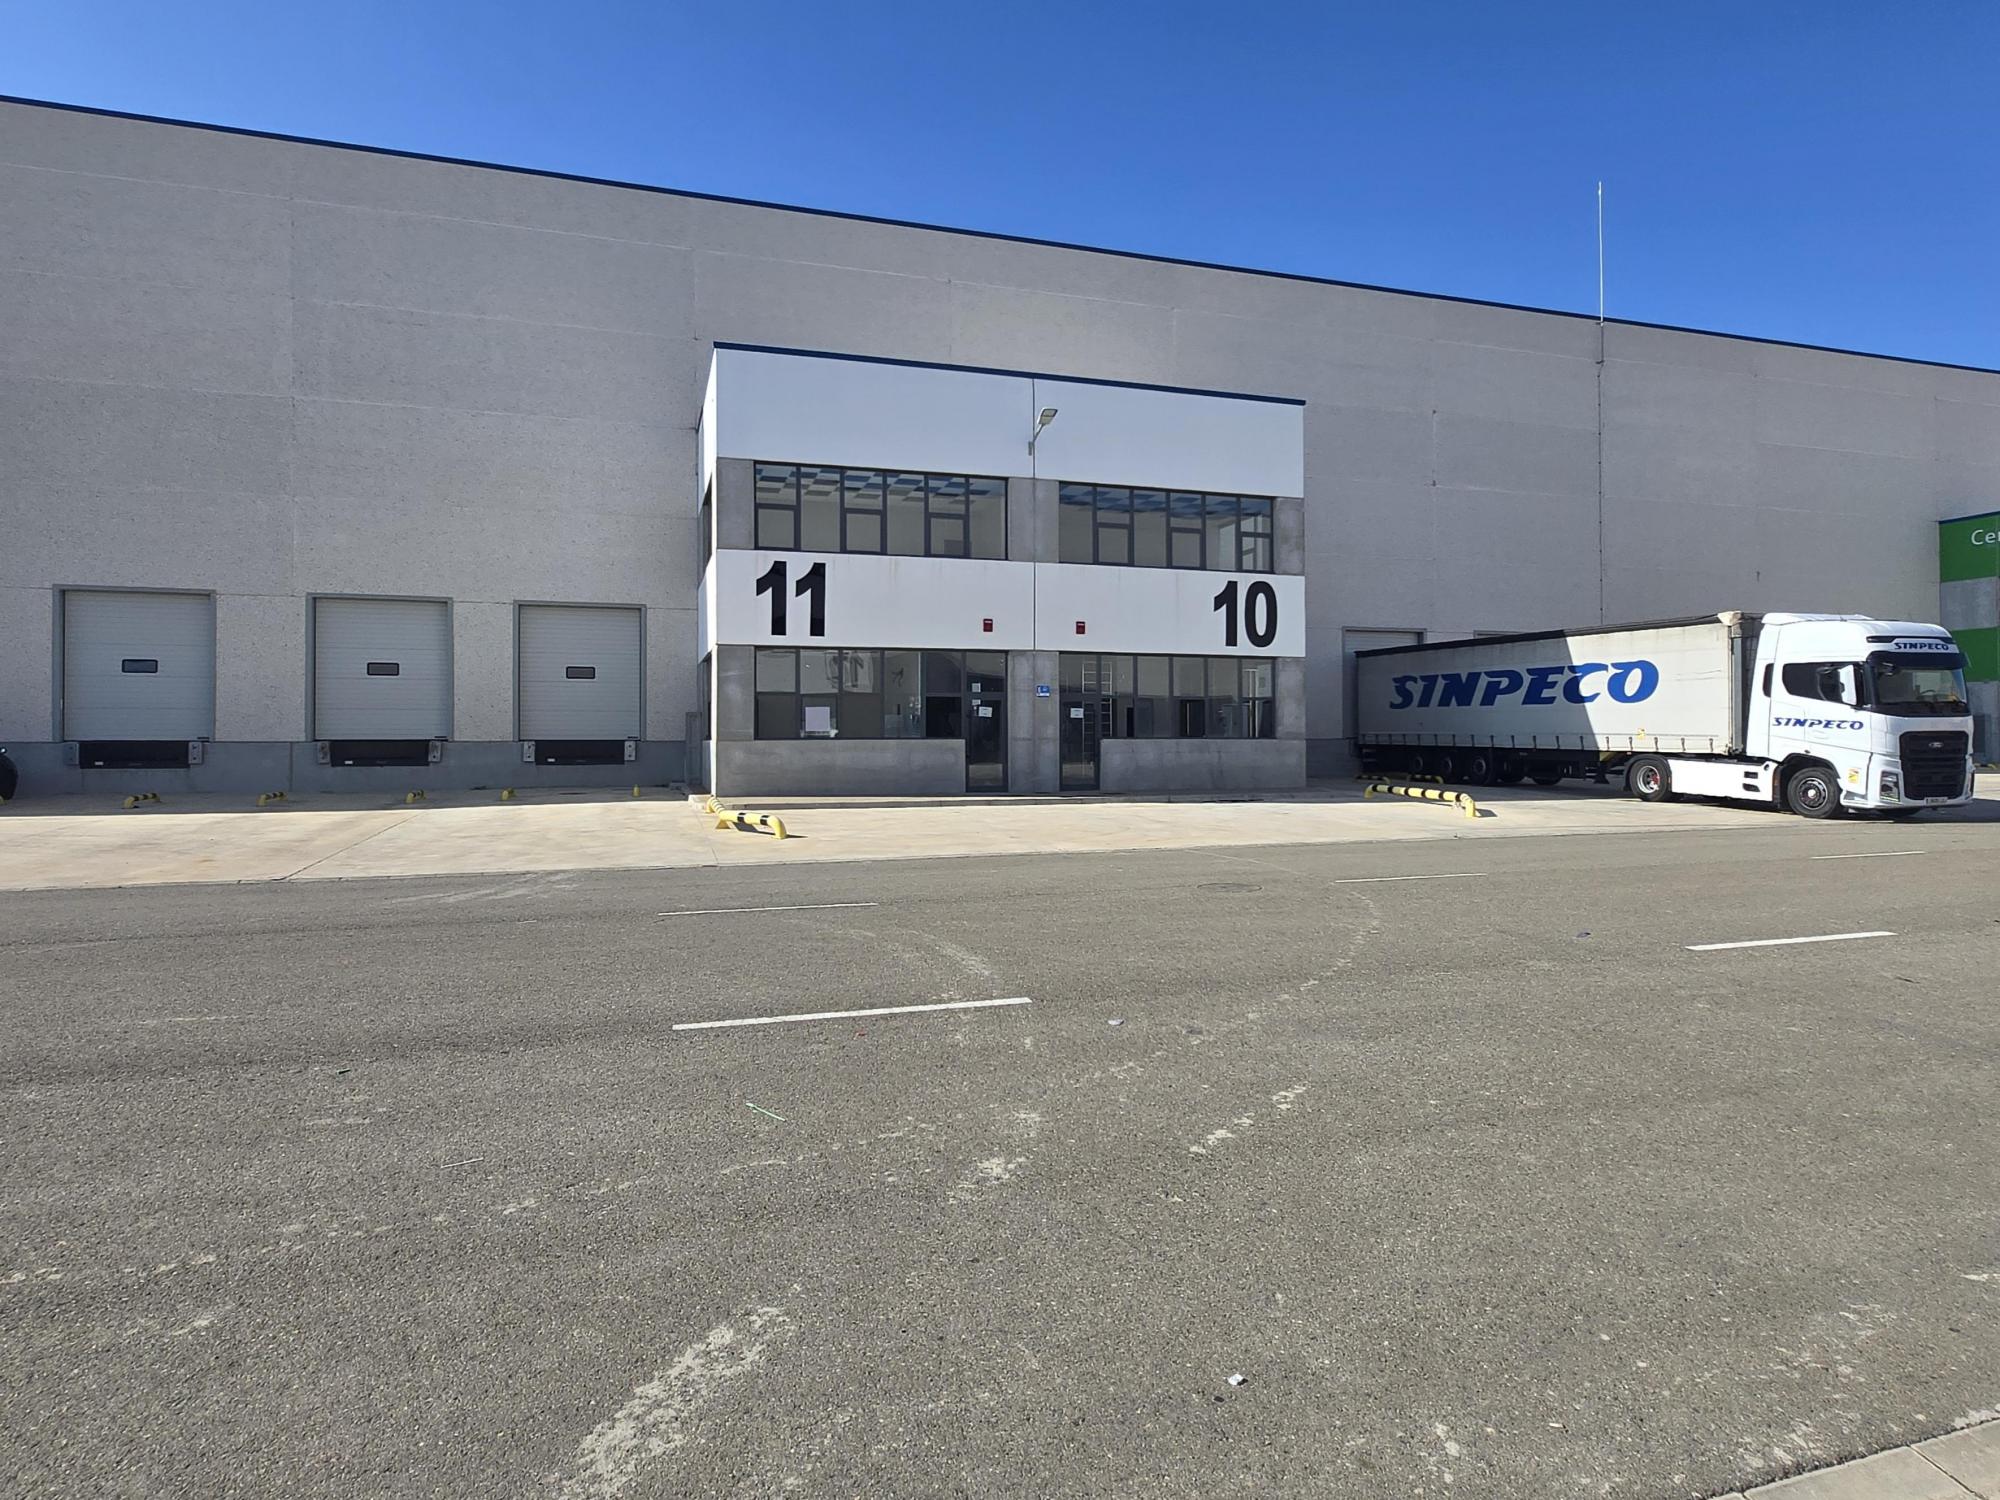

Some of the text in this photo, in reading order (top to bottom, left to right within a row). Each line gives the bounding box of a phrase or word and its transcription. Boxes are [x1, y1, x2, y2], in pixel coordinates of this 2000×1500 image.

[1971, 529, 2000, 545] Ce
[756, 560, 826, 637] 11
[1213, 580, 1278, 648] 10
[1893, 642, 1950, 651] SINPECO
[1389, 659, 1660, 710] SINPECO
[1772, 717, 1864, 731] SINPECO
